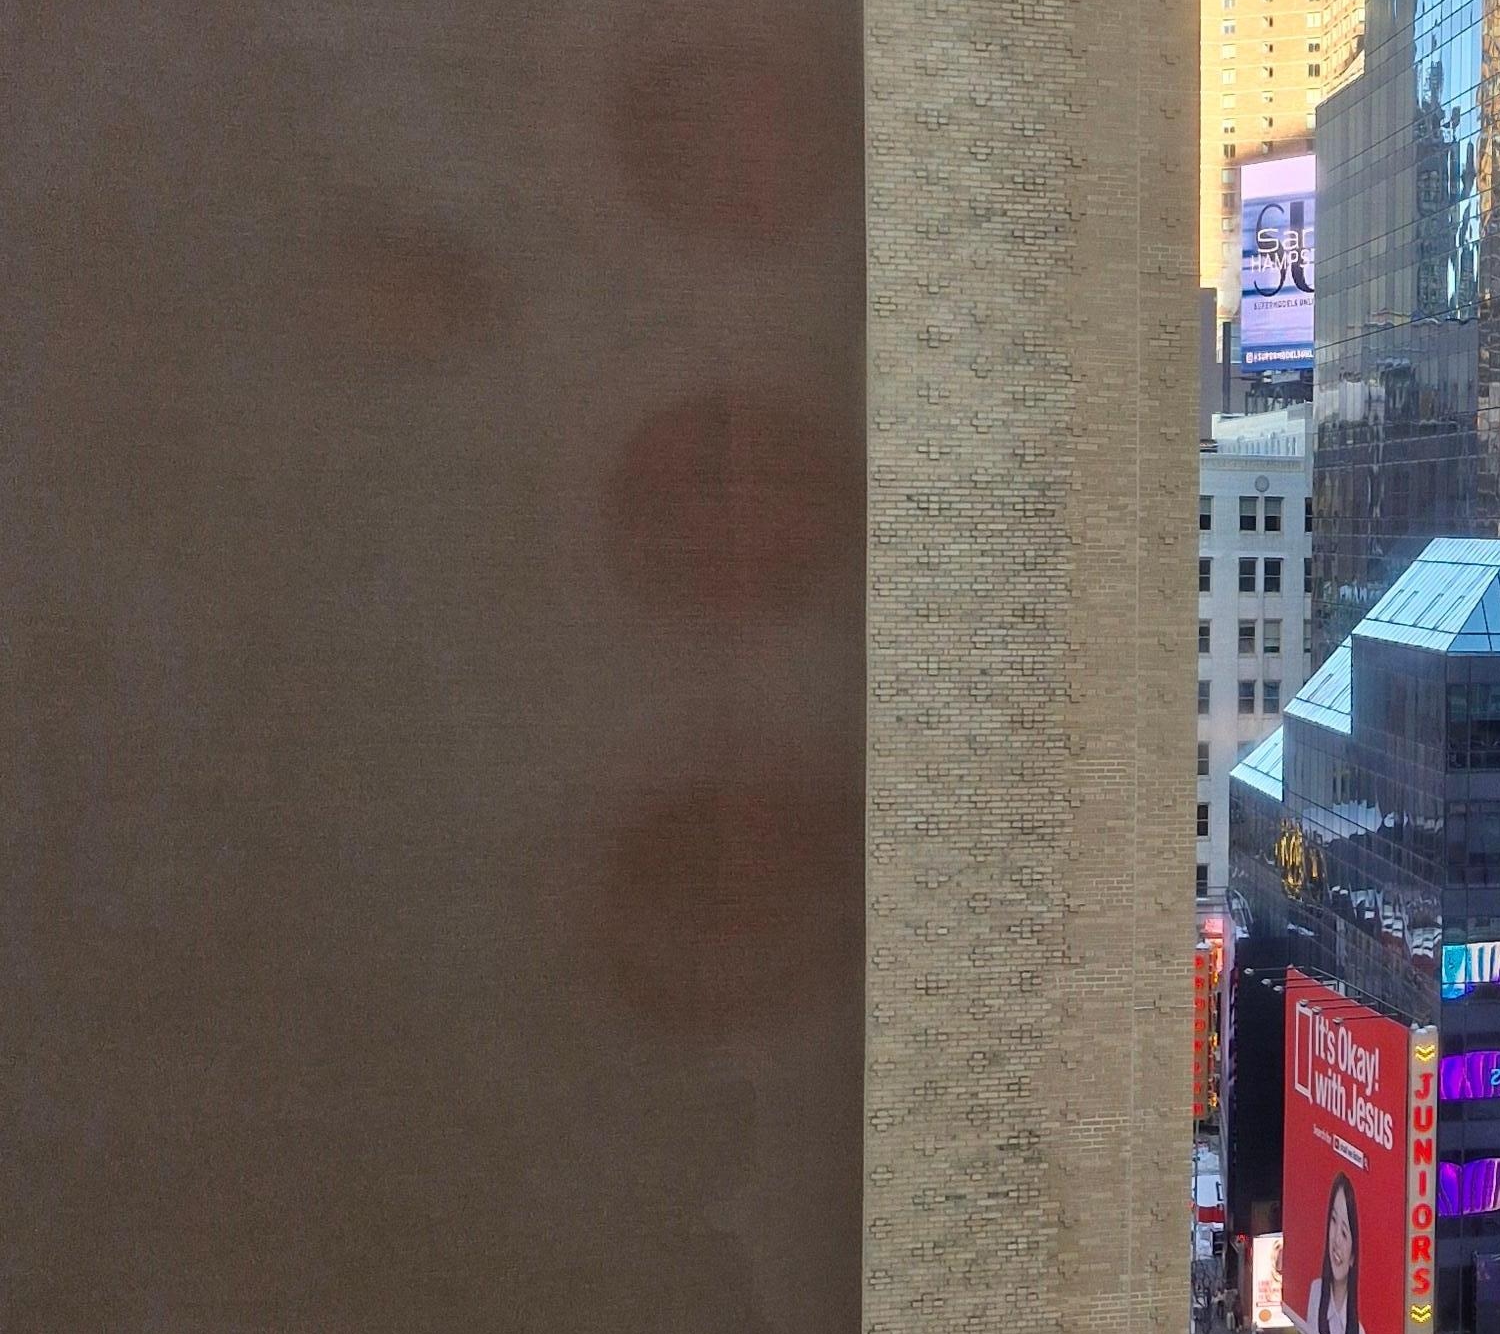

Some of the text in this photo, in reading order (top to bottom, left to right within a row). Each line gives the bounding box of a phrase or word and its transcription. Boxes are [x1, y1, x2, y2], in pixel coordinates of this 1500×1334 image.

[1251, 248, 1314, 274] HAMPS
[1315, 1015, 1380, 1097] It's Okay!
[1315, 1067, 1393, 1150] with Jesus
[1410, 1072, 1434, 1297] JUNIORS
